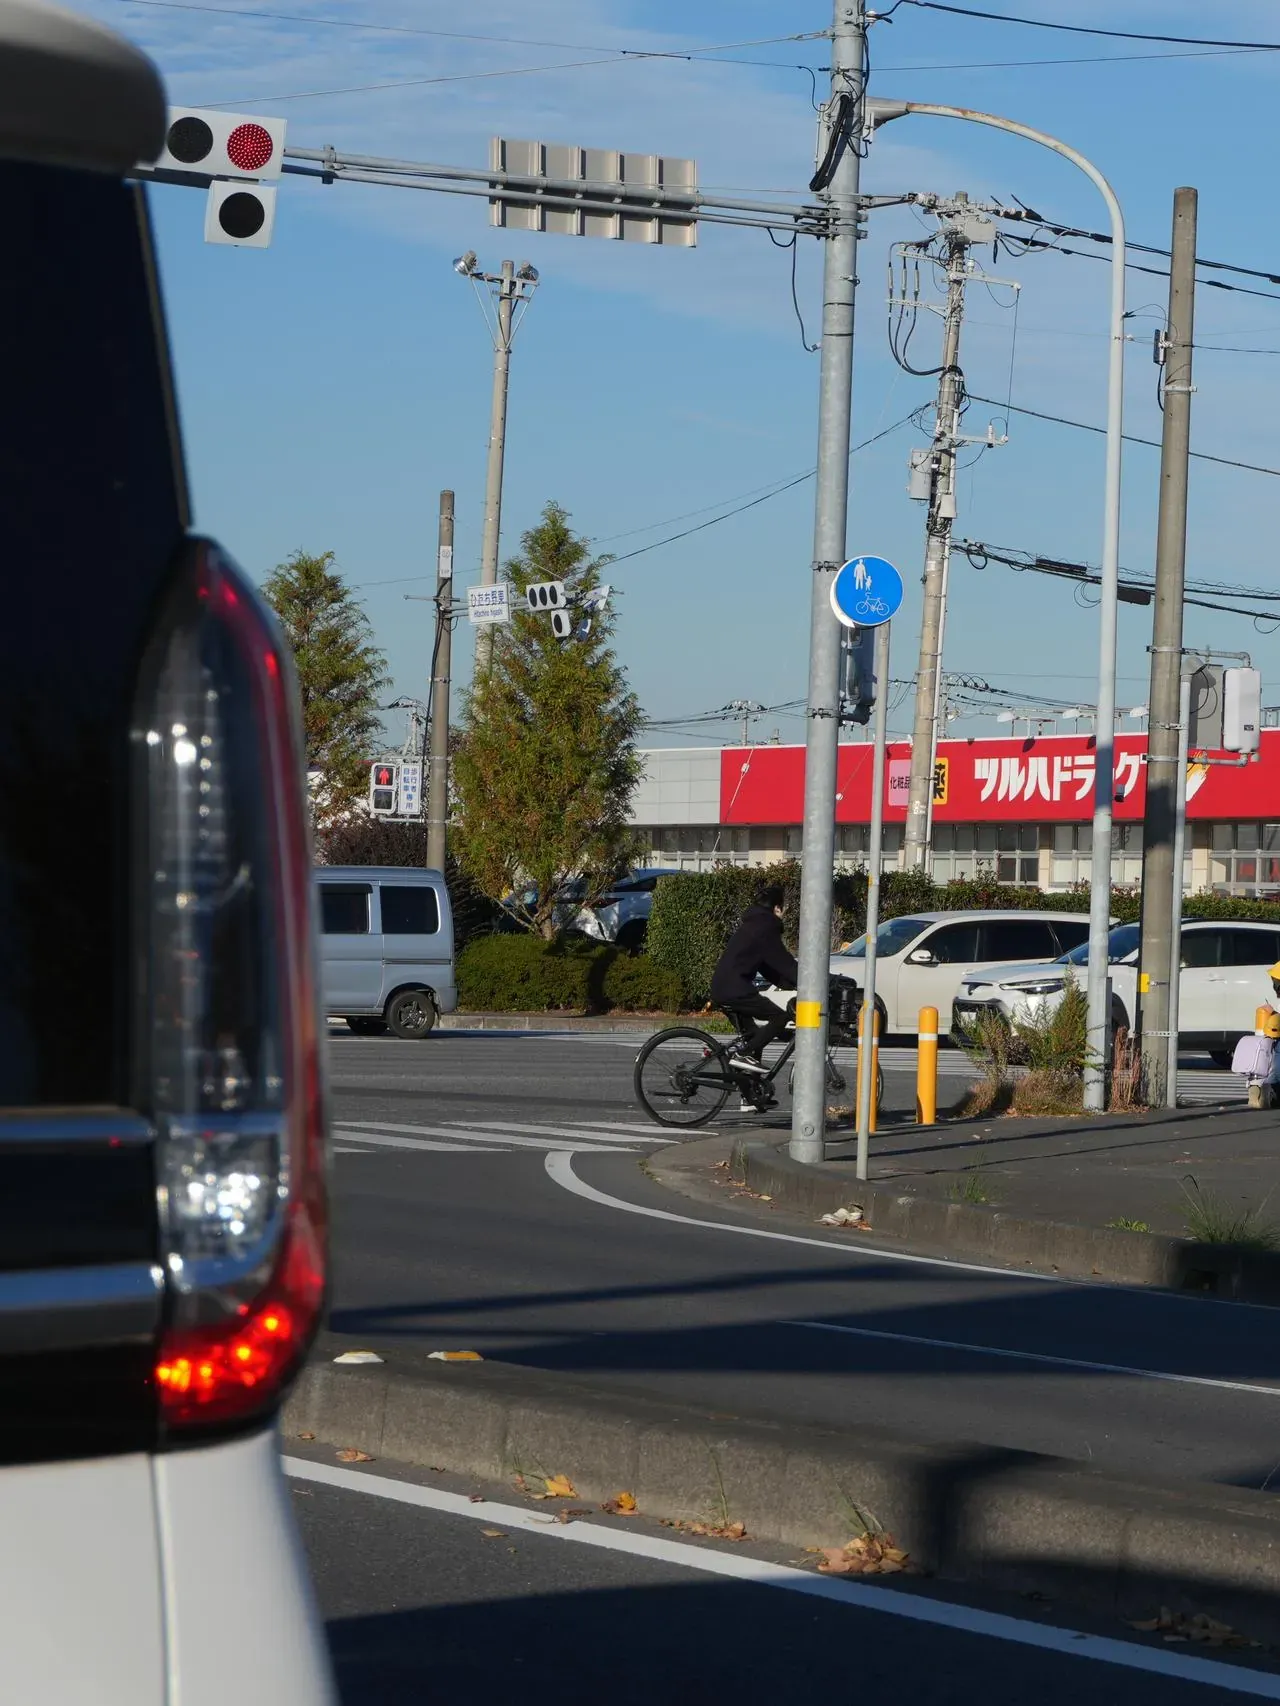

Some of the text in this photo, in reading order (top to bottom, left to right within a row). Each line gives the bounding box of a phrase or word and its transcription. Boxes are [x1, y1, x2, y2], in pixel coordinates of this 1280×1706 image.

[974, 752, 1148, 802] ツルハドラグ
